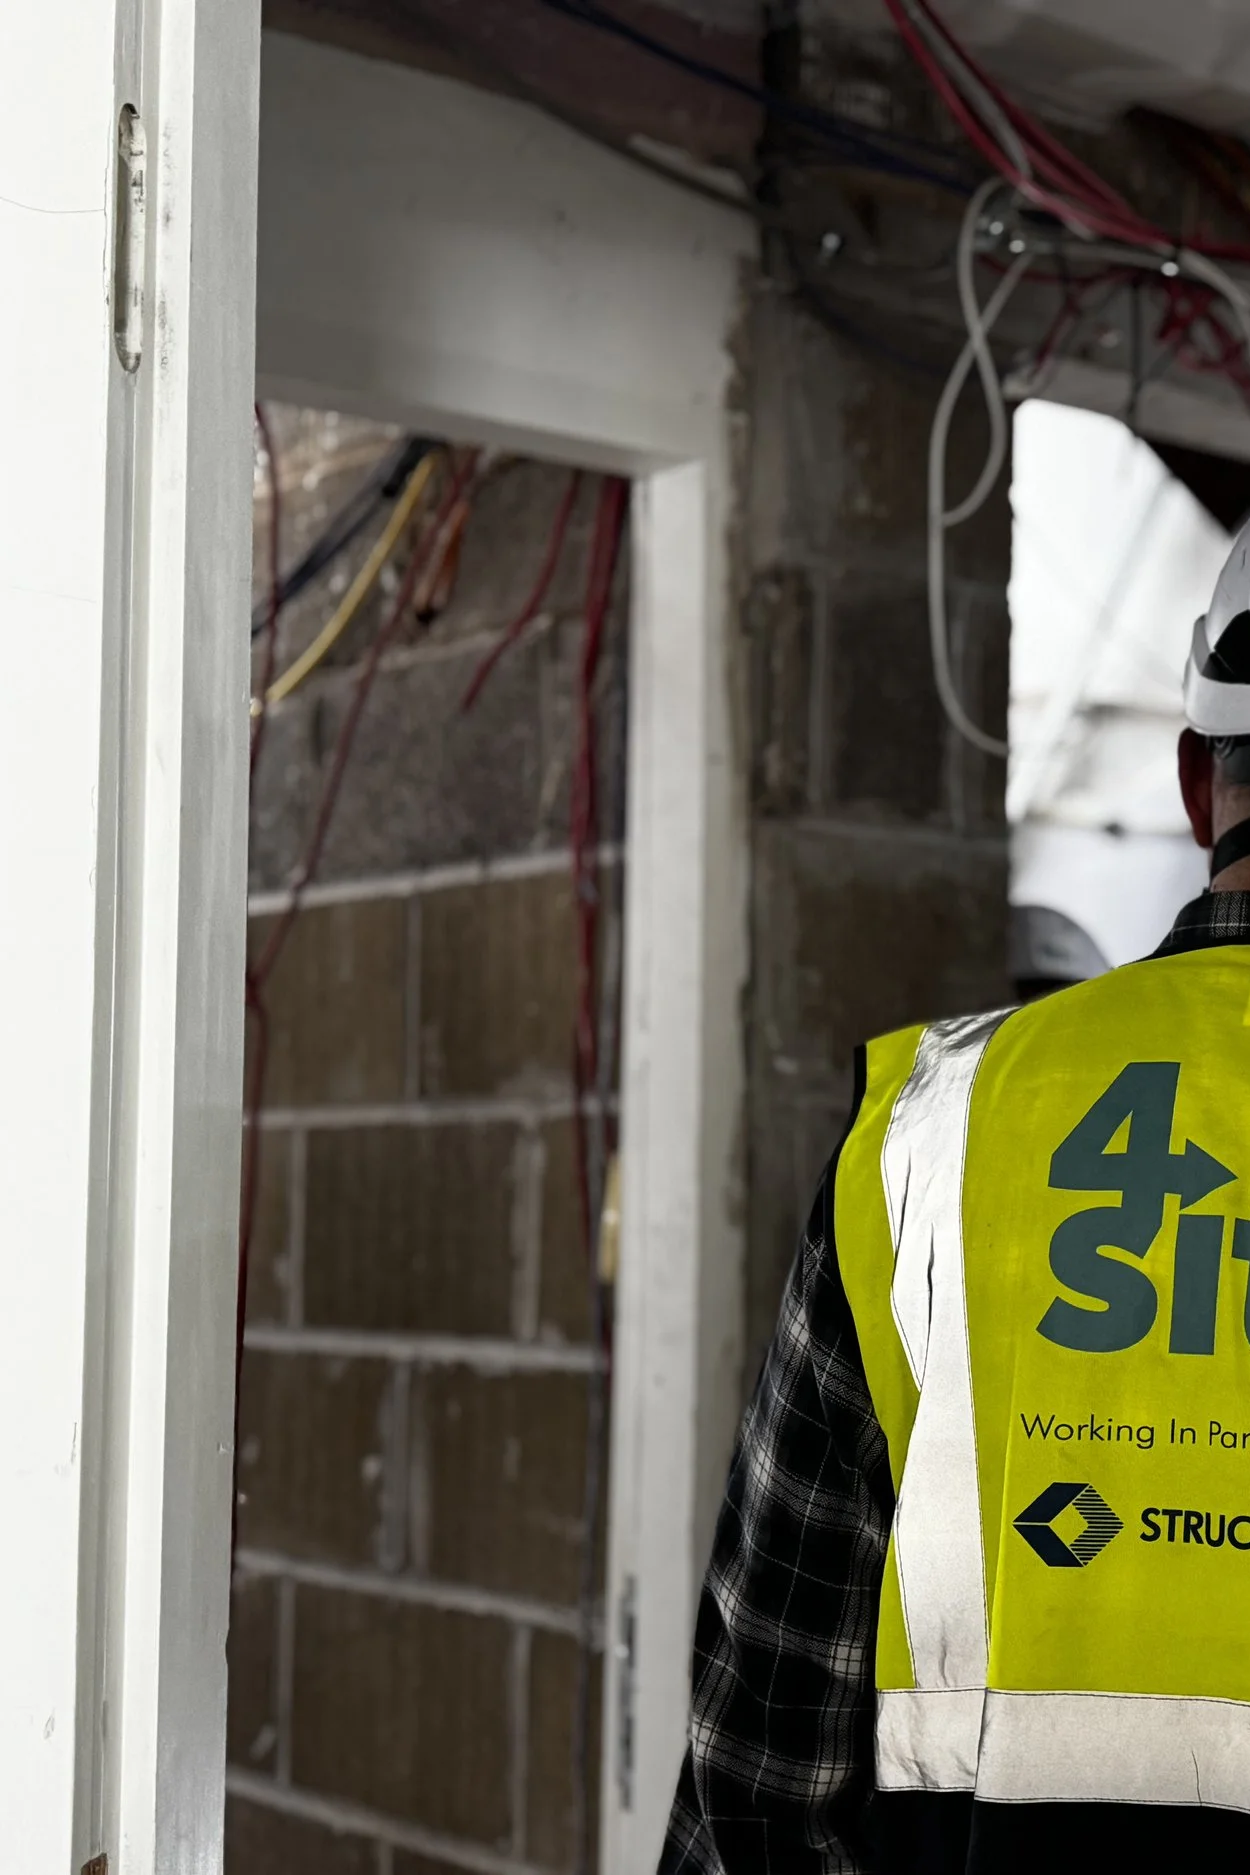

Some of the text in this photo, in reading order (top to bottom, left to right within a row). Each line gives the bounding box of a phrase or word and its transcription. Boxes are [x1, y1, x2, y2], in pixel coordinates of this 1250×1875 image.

[1047, 1061, 1238, 1211] 4
[1020, 1413, 1155, 1450] Working
[1170, 1419, 1196, 1445] In
